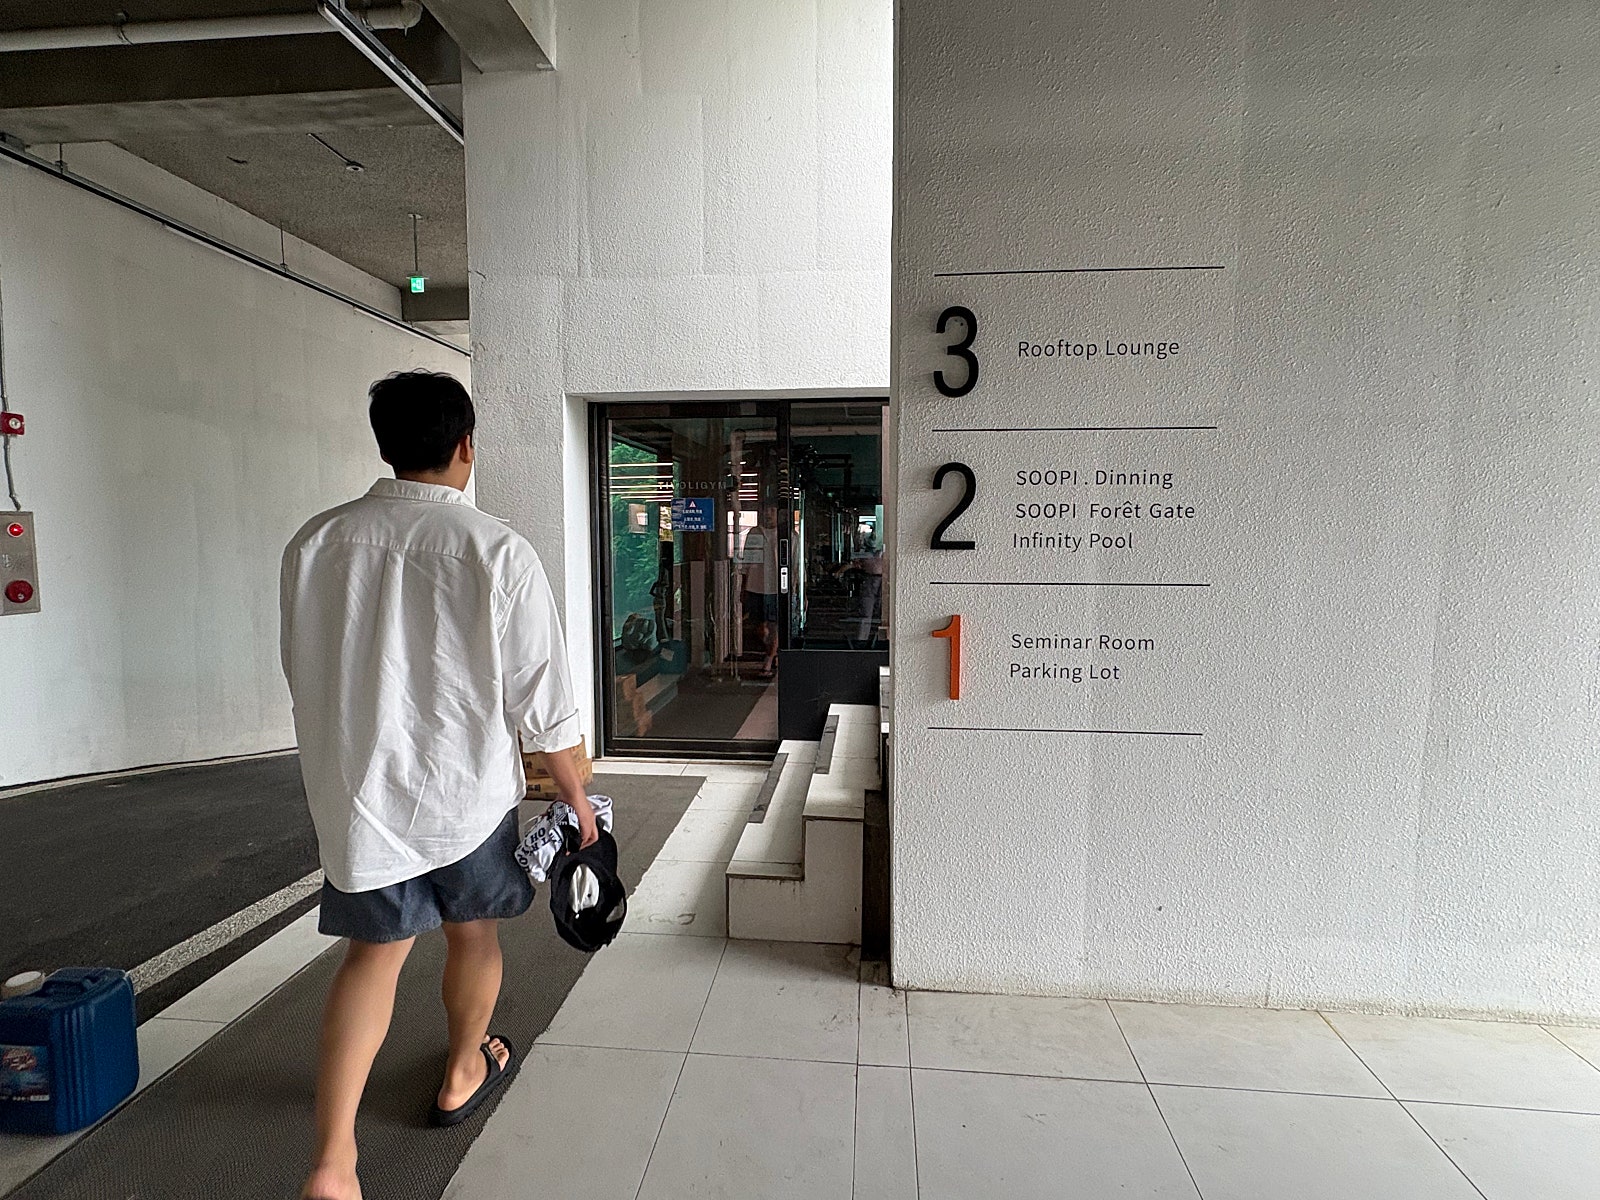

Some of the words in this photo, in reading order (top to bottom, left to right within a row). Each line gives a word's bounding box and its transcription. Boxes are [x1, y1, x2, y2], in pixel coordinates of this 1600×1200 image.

[933, 305, 979, 398] 3
[1018, 338, 1098, 361] Rooftop
[1106, 340, 1180, 360] Lounge
[1016, 470, 1077, 486] SOOPI
[1095, 469, 1174, 490] Dinning
[930, 462, 977, 550] 2
[1015, 503, 1077, 519] SOOPI
[1090, 500, 1141, 519] Forêt
[1149, 503, 1196, 519] Gate
[1013, 531, 1082, 553] Infinity
[1089, 532, 1133, 549] Pool
[1011, 633, 1092, 651] Seminar
[1099, 634, 1155, 651] Room
[931, 614, 962, 701] 1
[1010, 662, 1083, 684] Parking
[1089, 664, 1120, 680] Lot
